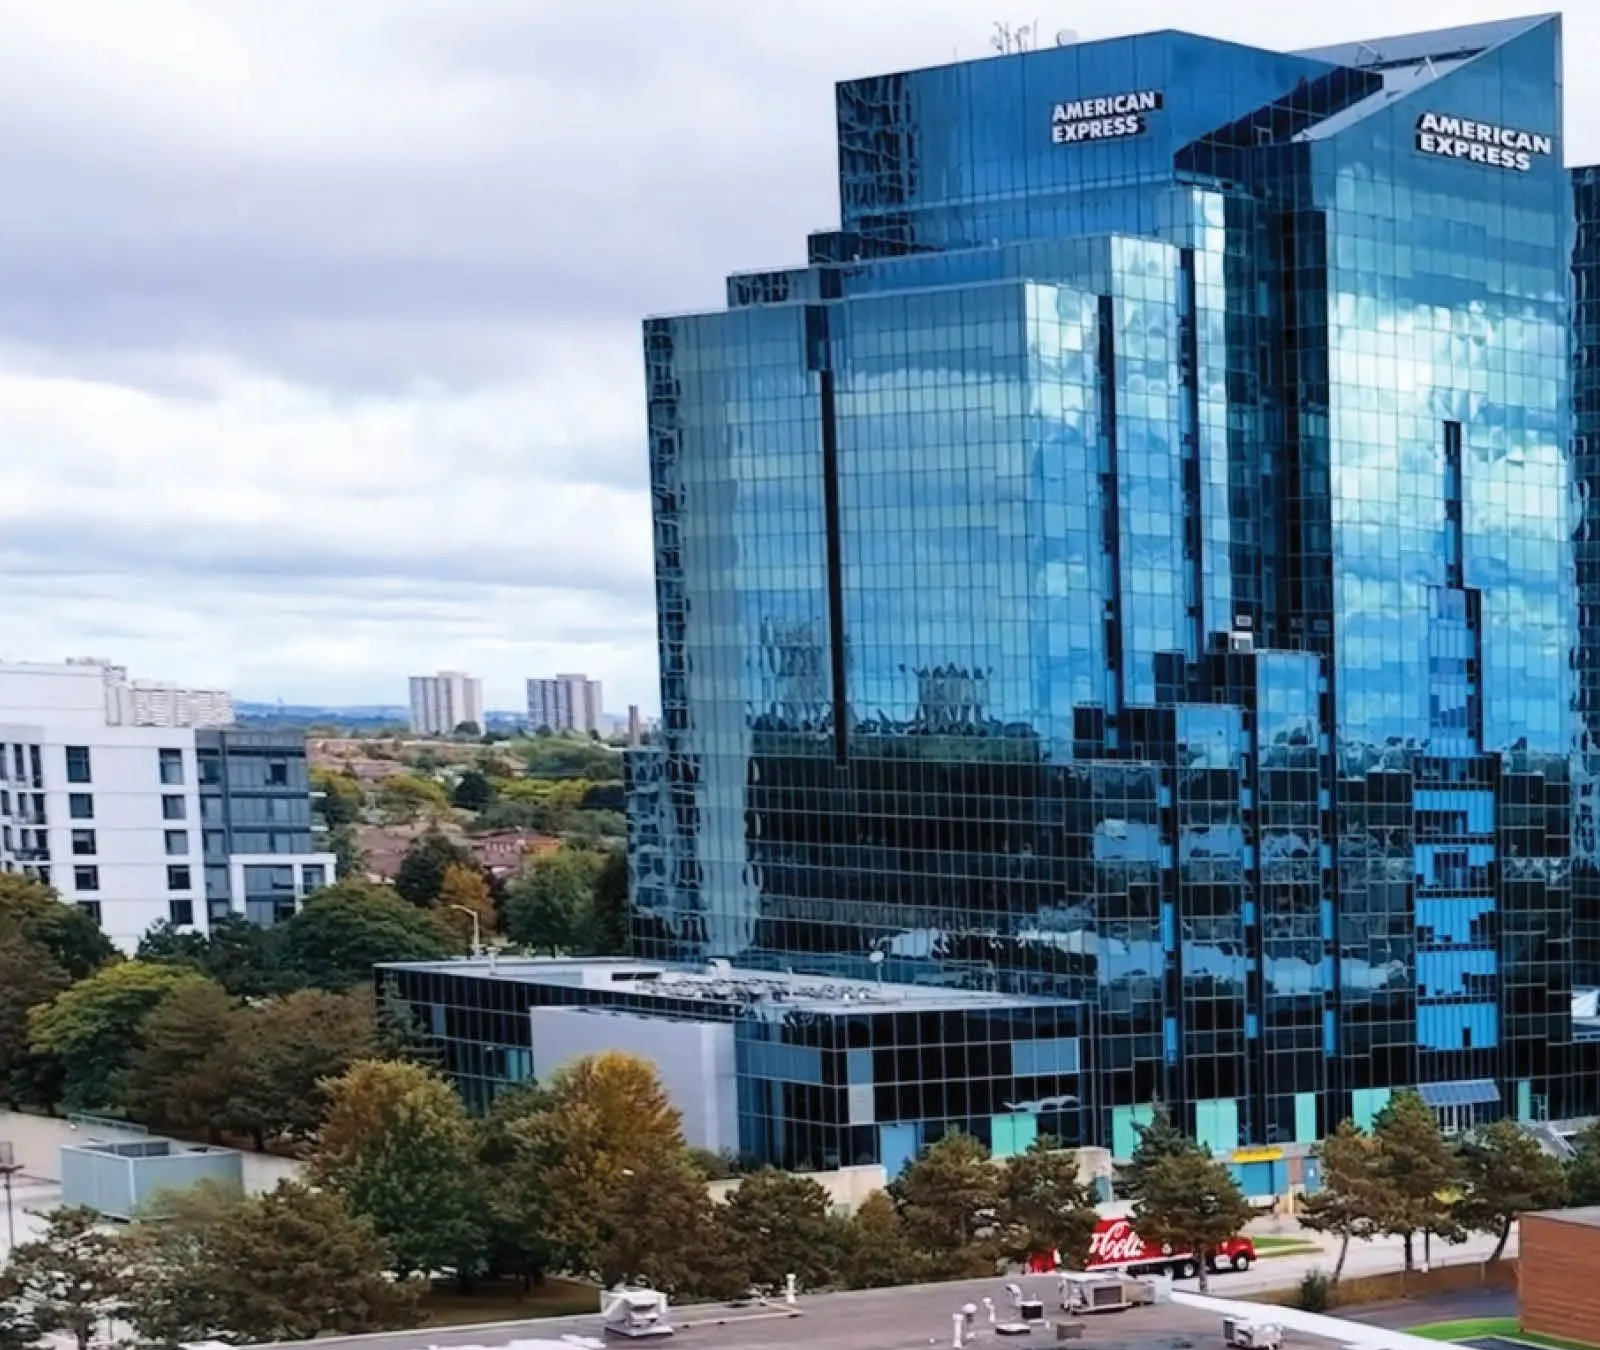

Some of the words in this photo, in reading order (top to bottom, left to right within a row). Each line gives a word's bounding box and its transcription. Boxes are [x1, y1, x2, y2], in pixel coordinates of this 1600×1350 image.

[1052, 91, 1155, 122] AMERICAN
[1052, 115, 1138, 143] EXPRESS
[1421, 112, 1551, 154] AMERICAN
[1420, 133, 1531, 171] EXPRESS
